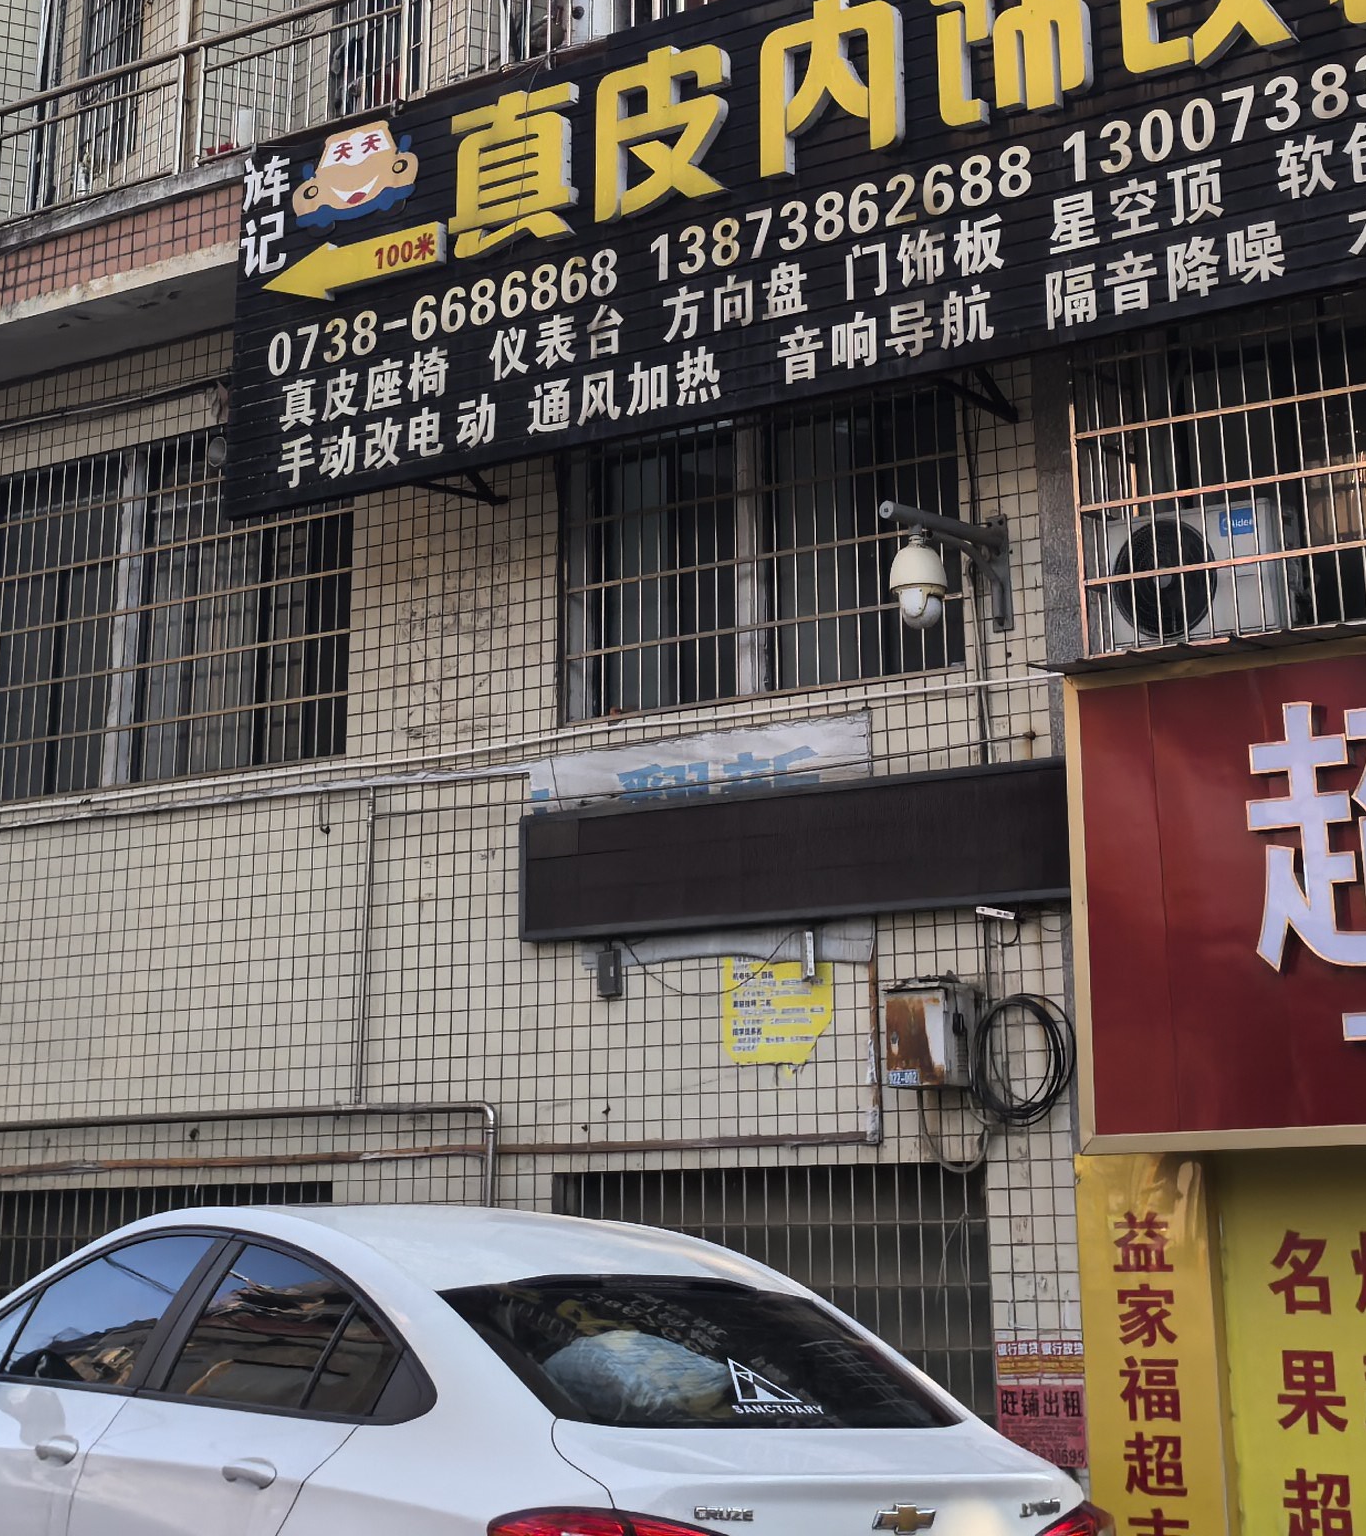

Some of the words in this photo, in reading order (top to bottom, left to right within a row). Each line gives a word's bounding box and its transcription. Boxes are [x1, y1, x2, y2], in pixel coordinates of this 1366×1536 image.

[333, 133, 382, 162] 天天
[240, 155, 291, 278] 辉记
[268, 249, 619, 376] 0738-6686868
[650, 144, 1032, 282] 13873862688
[374, 232, 435, 270] 100米
[279, 346, 449, 432] 真皮座椅
[488, 302, 626, 381] 仪表台
[662, 260, 808, 342] 方向盘
[844, 215, 1005, 301] 门饰板
[1048, 159, 1224, 255] 星空顶
[277, 393, 497, 489] 手动改电动
[527, 346, 722, 436] 通风加热
[777, 286, 995, 386] 音响导航
[1045, 220, 1287, 331] 隔音降噪
[731, 1405, 825, 1415] SANCTUARY
[1000, 1388, 1084, 1418] 旺铺出租
[693, 1505, 754, 1522] CRUZE
